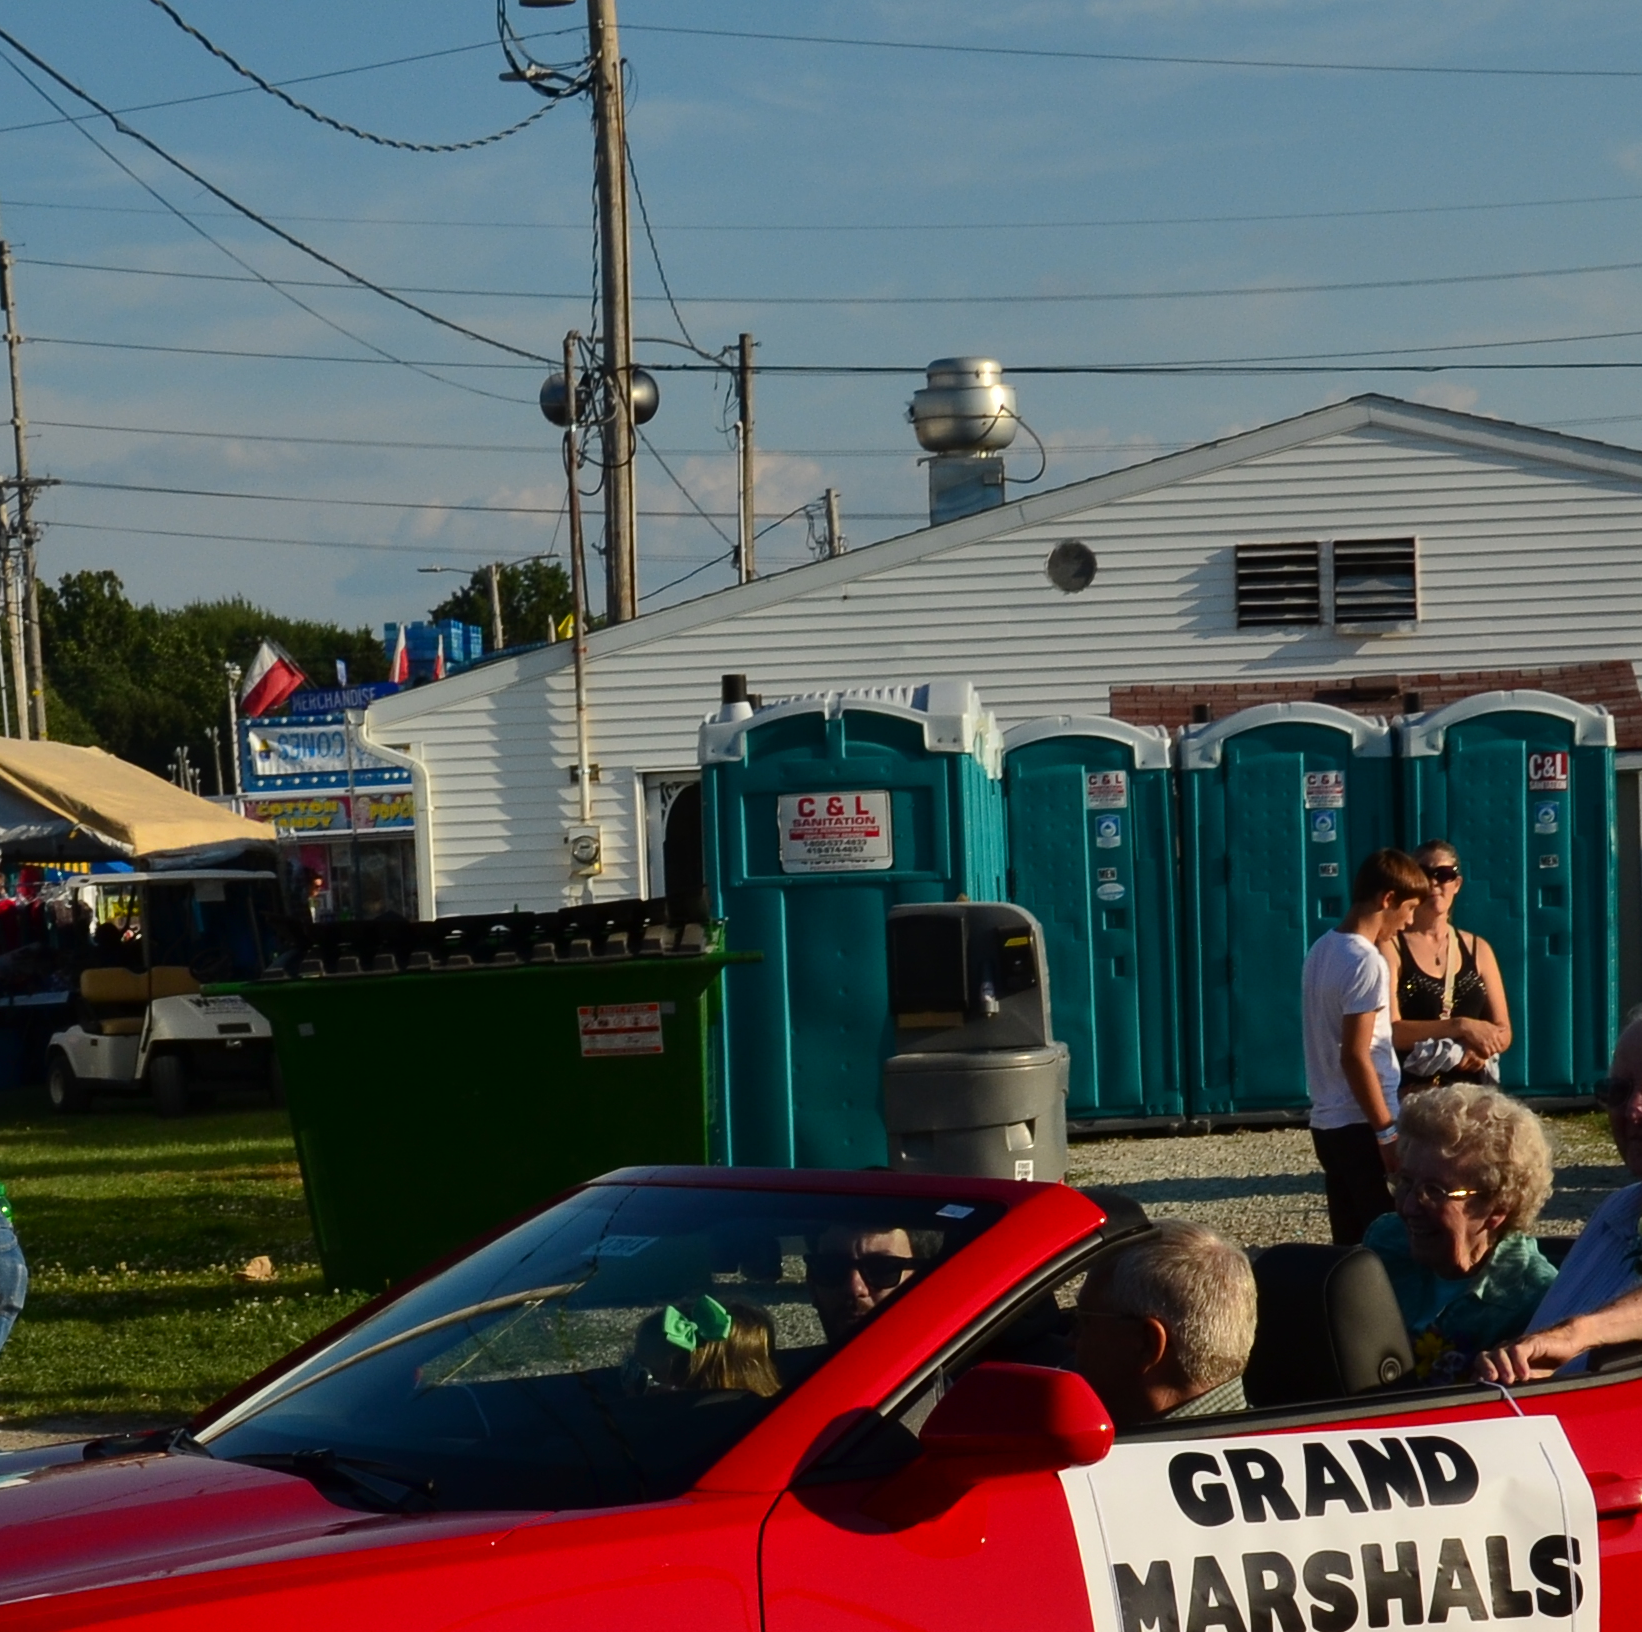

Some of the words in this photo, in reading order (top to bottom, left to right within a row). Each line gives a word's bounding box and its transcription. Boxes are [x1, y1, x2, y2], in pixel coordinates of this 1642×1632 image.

[292, 687, 376, 711] MERCHANDISE
[1529, 753, 1567, 780] C&L
[1088, 774, 1098, 785] C
[1101, 774, 1110, 785] &
[1115, 773, 1122, 784] L
[1307, 775, 1317, 785] C
[1320, 775, 1330, 785] &
[1334, 775, 1342, 784] L
[256, 801, 340, 816] COTTON
[797, 797, 816, 817] C
[826, 796, 844, 816] &
[855, 795, 870, 816] L
[267, 816, 334, 829] ANDY
[792, 816, 876, 828] SANITATION
[1168, 1435, 1479, 1527] GRAND
